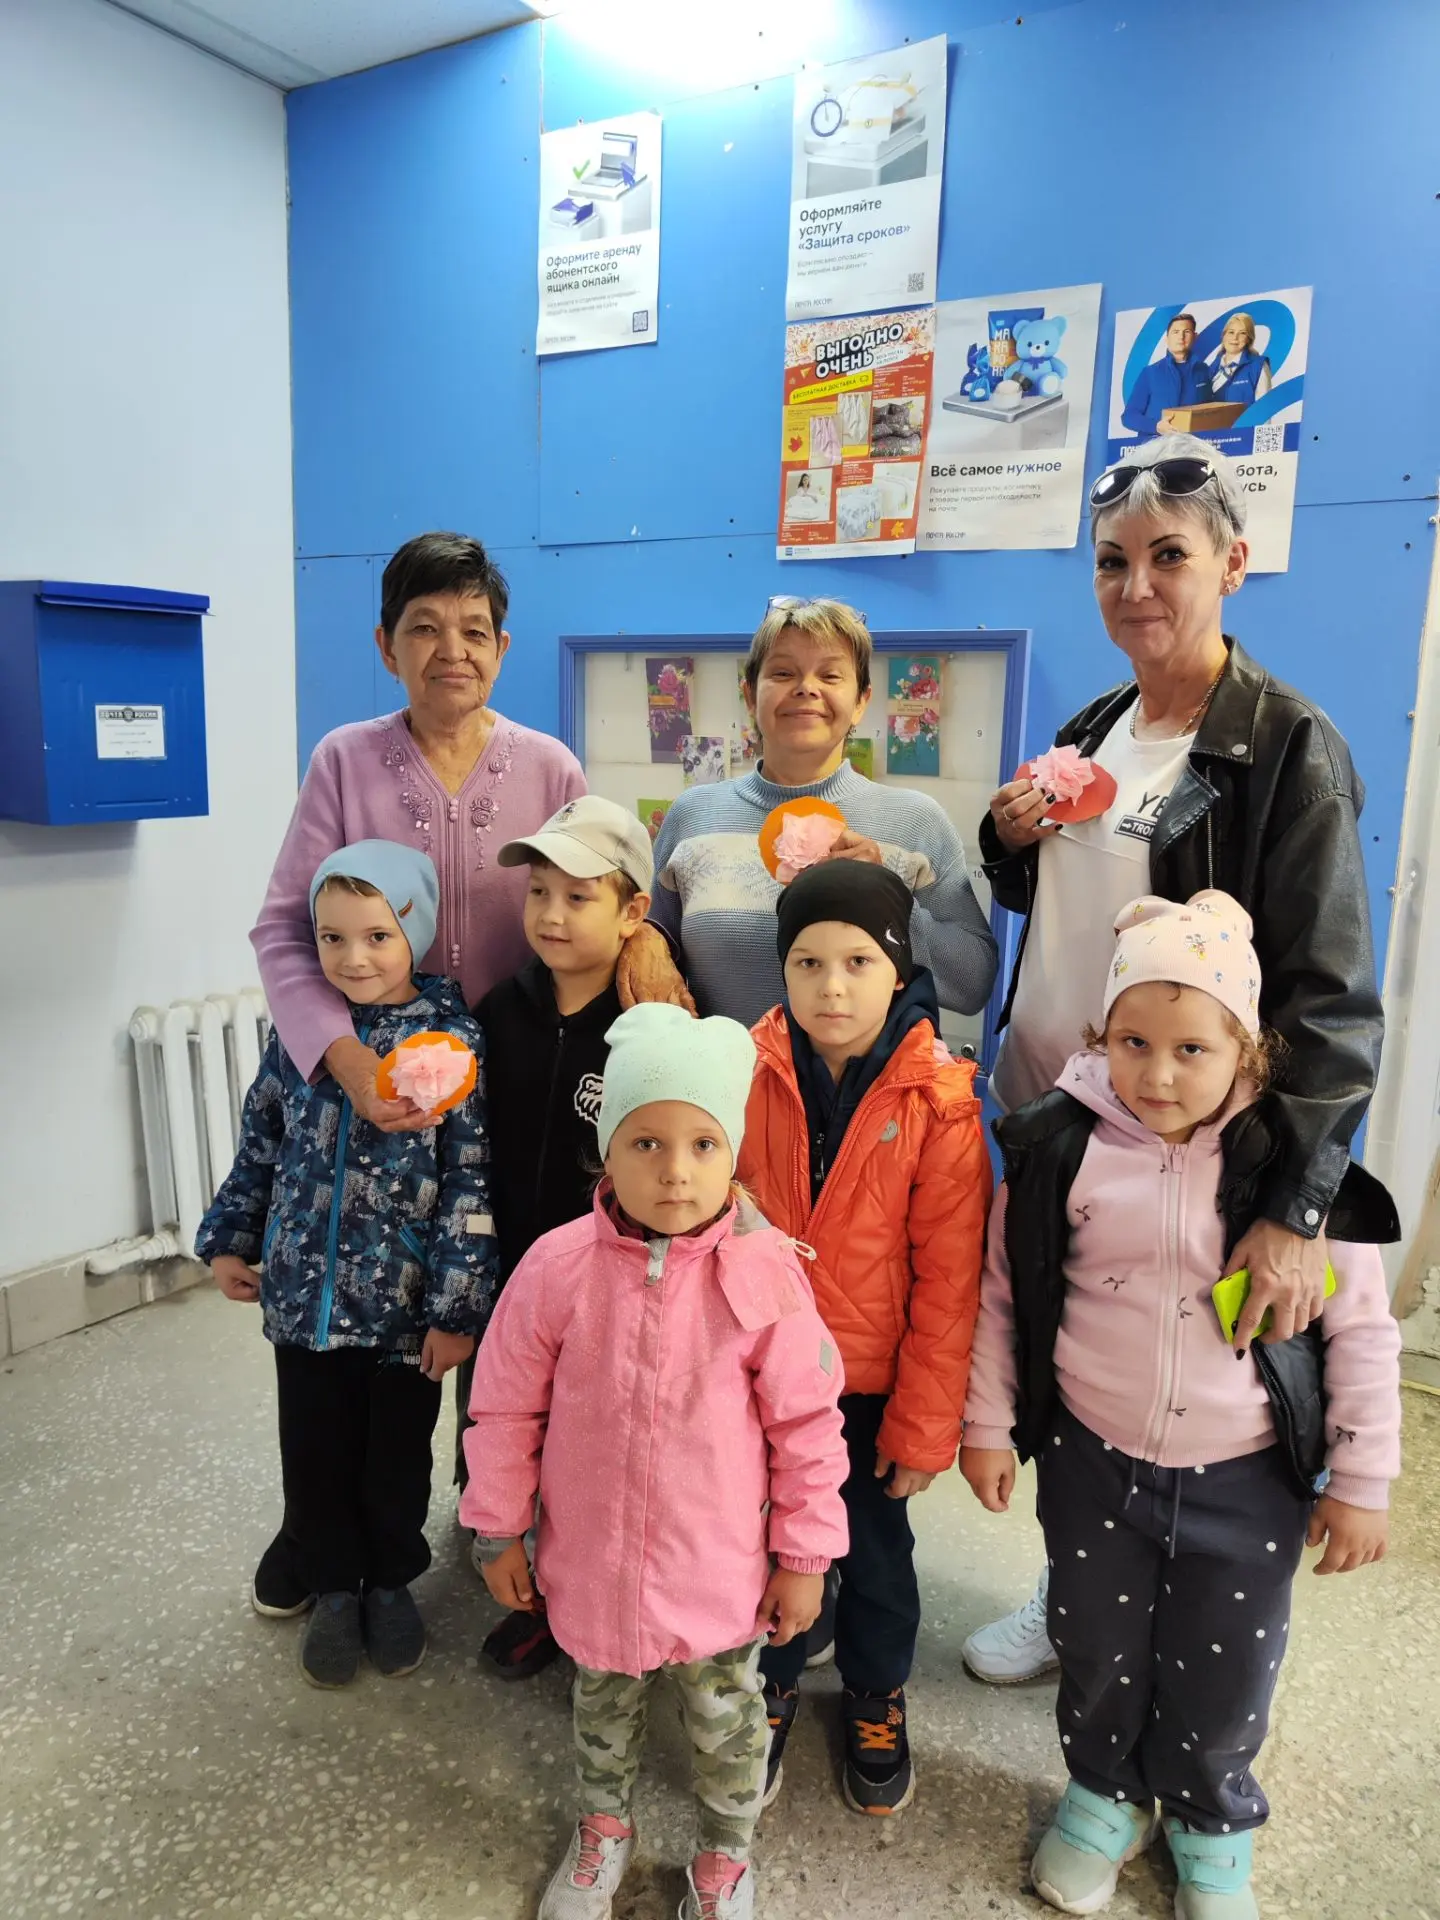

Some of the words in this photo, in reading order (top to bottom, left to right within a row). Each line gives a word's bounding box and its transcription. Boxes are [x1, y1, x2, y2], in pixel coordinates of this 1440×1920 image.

[800, 198, 882, 222] Оформляйте
[798, 234, 853, 250] «Защита
[857, 224, 911, 244] сроков»
[799, 220, 843, 239] услугу
[546, 251, 600, 268] Оформите
[602, 244, 642, 259] аренду
[546, 261, 618, 280] абонентского
[547, 281, 579, 293] ящика
[582, 273, 620, 288] онлайн
[815, 323, 904, 361] ВЫГОДНО
[815, 350, 874, 379] ОЧЕНЬ
[931, 464, 957, 477] Всё
[960, 465, 1004, 476] самое
[1006, 461, 1062, 476] нужное
[1236, 464, 1278, 477] бота,
[1241, 484, 1267, 493] усь
[977, 730, 983, 738] 9
[1137, 792, 1169, 818] YE
[972, 870, 983, 878] 10
